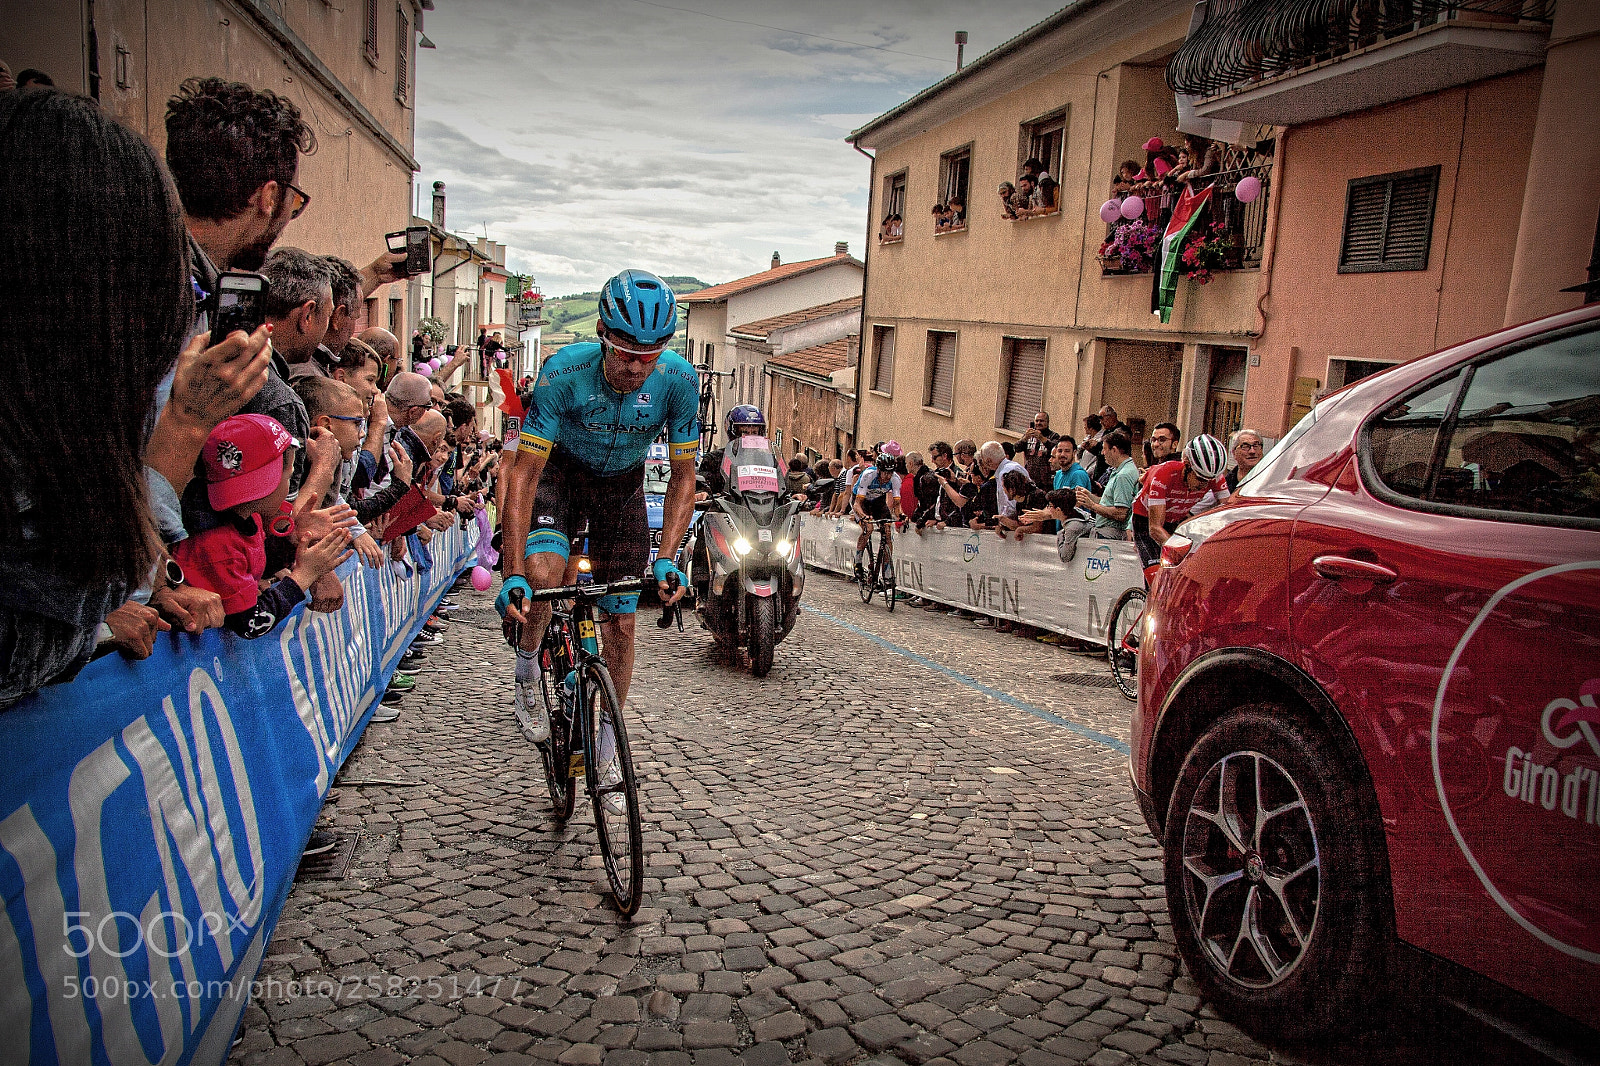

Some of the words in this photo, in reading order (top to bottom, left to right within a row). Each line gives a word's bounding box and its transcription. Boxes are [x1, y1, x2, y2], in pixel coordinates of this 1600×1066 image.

[549, 370, 560, 379] air
[562, 361, 592, 375] astana
[667, 366, 680, 375] air
[526, 539, 556, 548] PREMIER
[963, 543, 980, 554] TENA
[1087, 558, 1111, 572] TENA
[966, 572, 1020, 616] MEN
[1503, 745, 1557, 812] Giro
